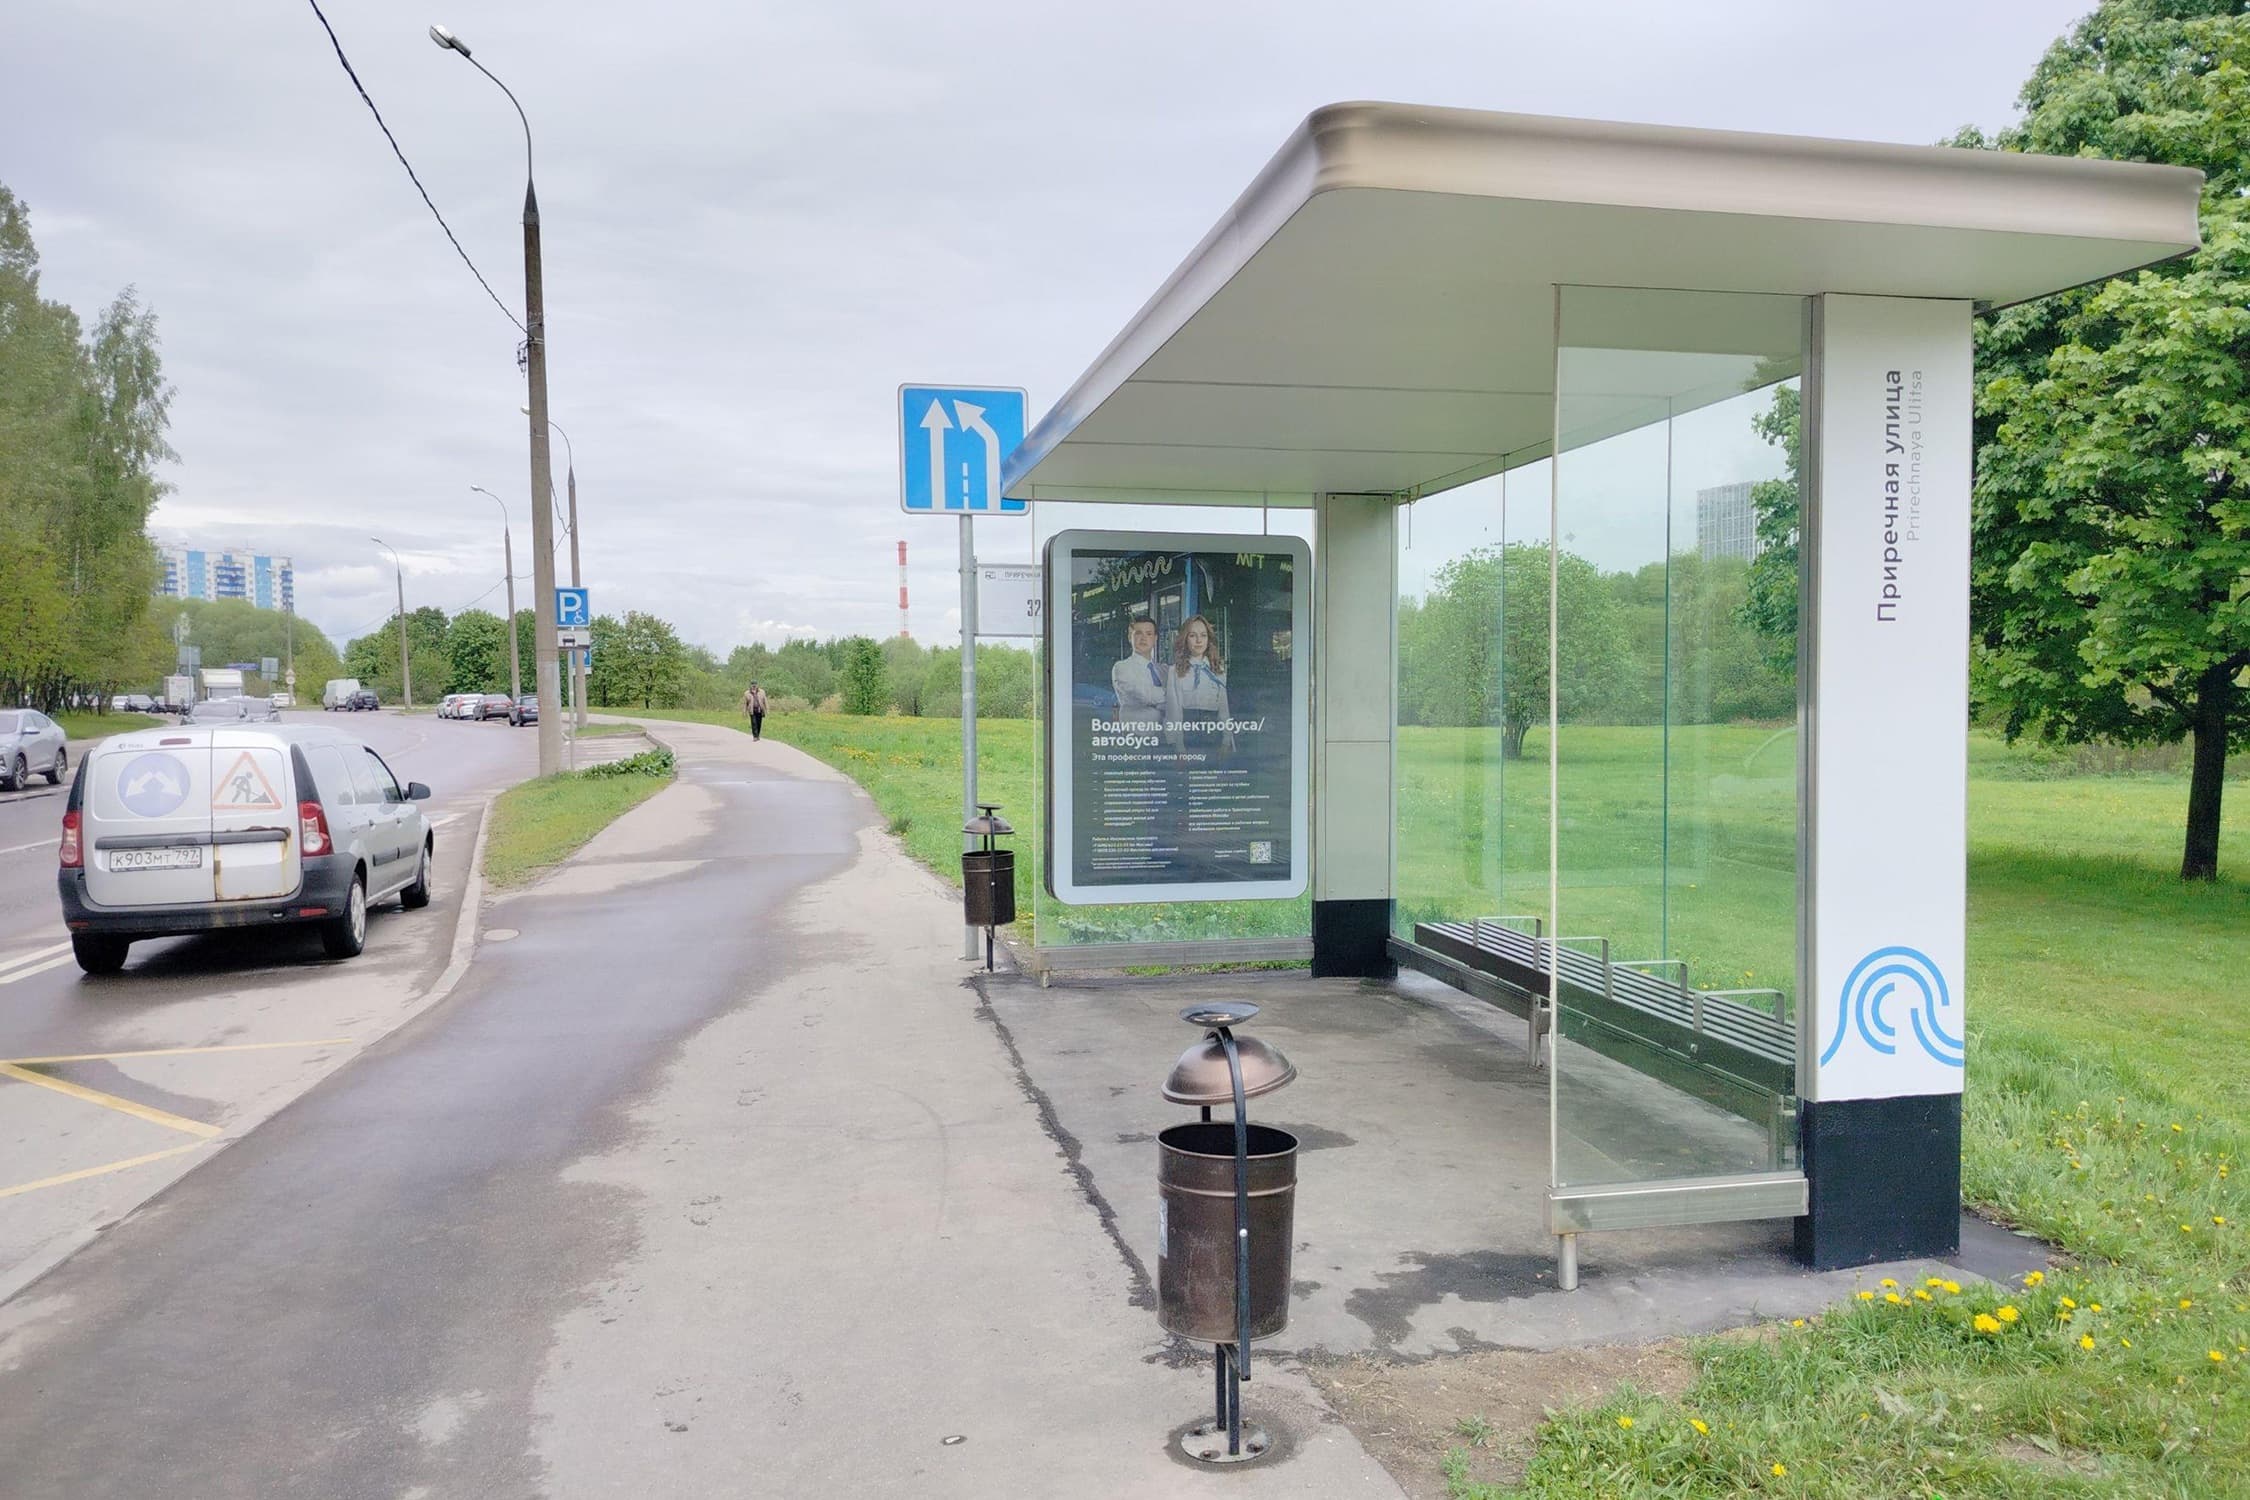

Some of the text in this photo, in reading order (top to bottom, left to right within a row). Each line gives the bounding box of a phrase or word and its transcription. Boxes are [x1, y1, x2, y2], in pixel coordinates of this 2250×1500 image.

[1906, 369, 1924, 542] Prirechnaya Ulitsa
[1877, 369, 1904, 622] Приречная улица
[559, 591, 582, 622] P
[1091, 716, 1266, 734] Водитель электробуса/
[1091, 733, 1159, 749] автобуса
[1092, 753, 1207, 763] Эта профессия нужна городу
